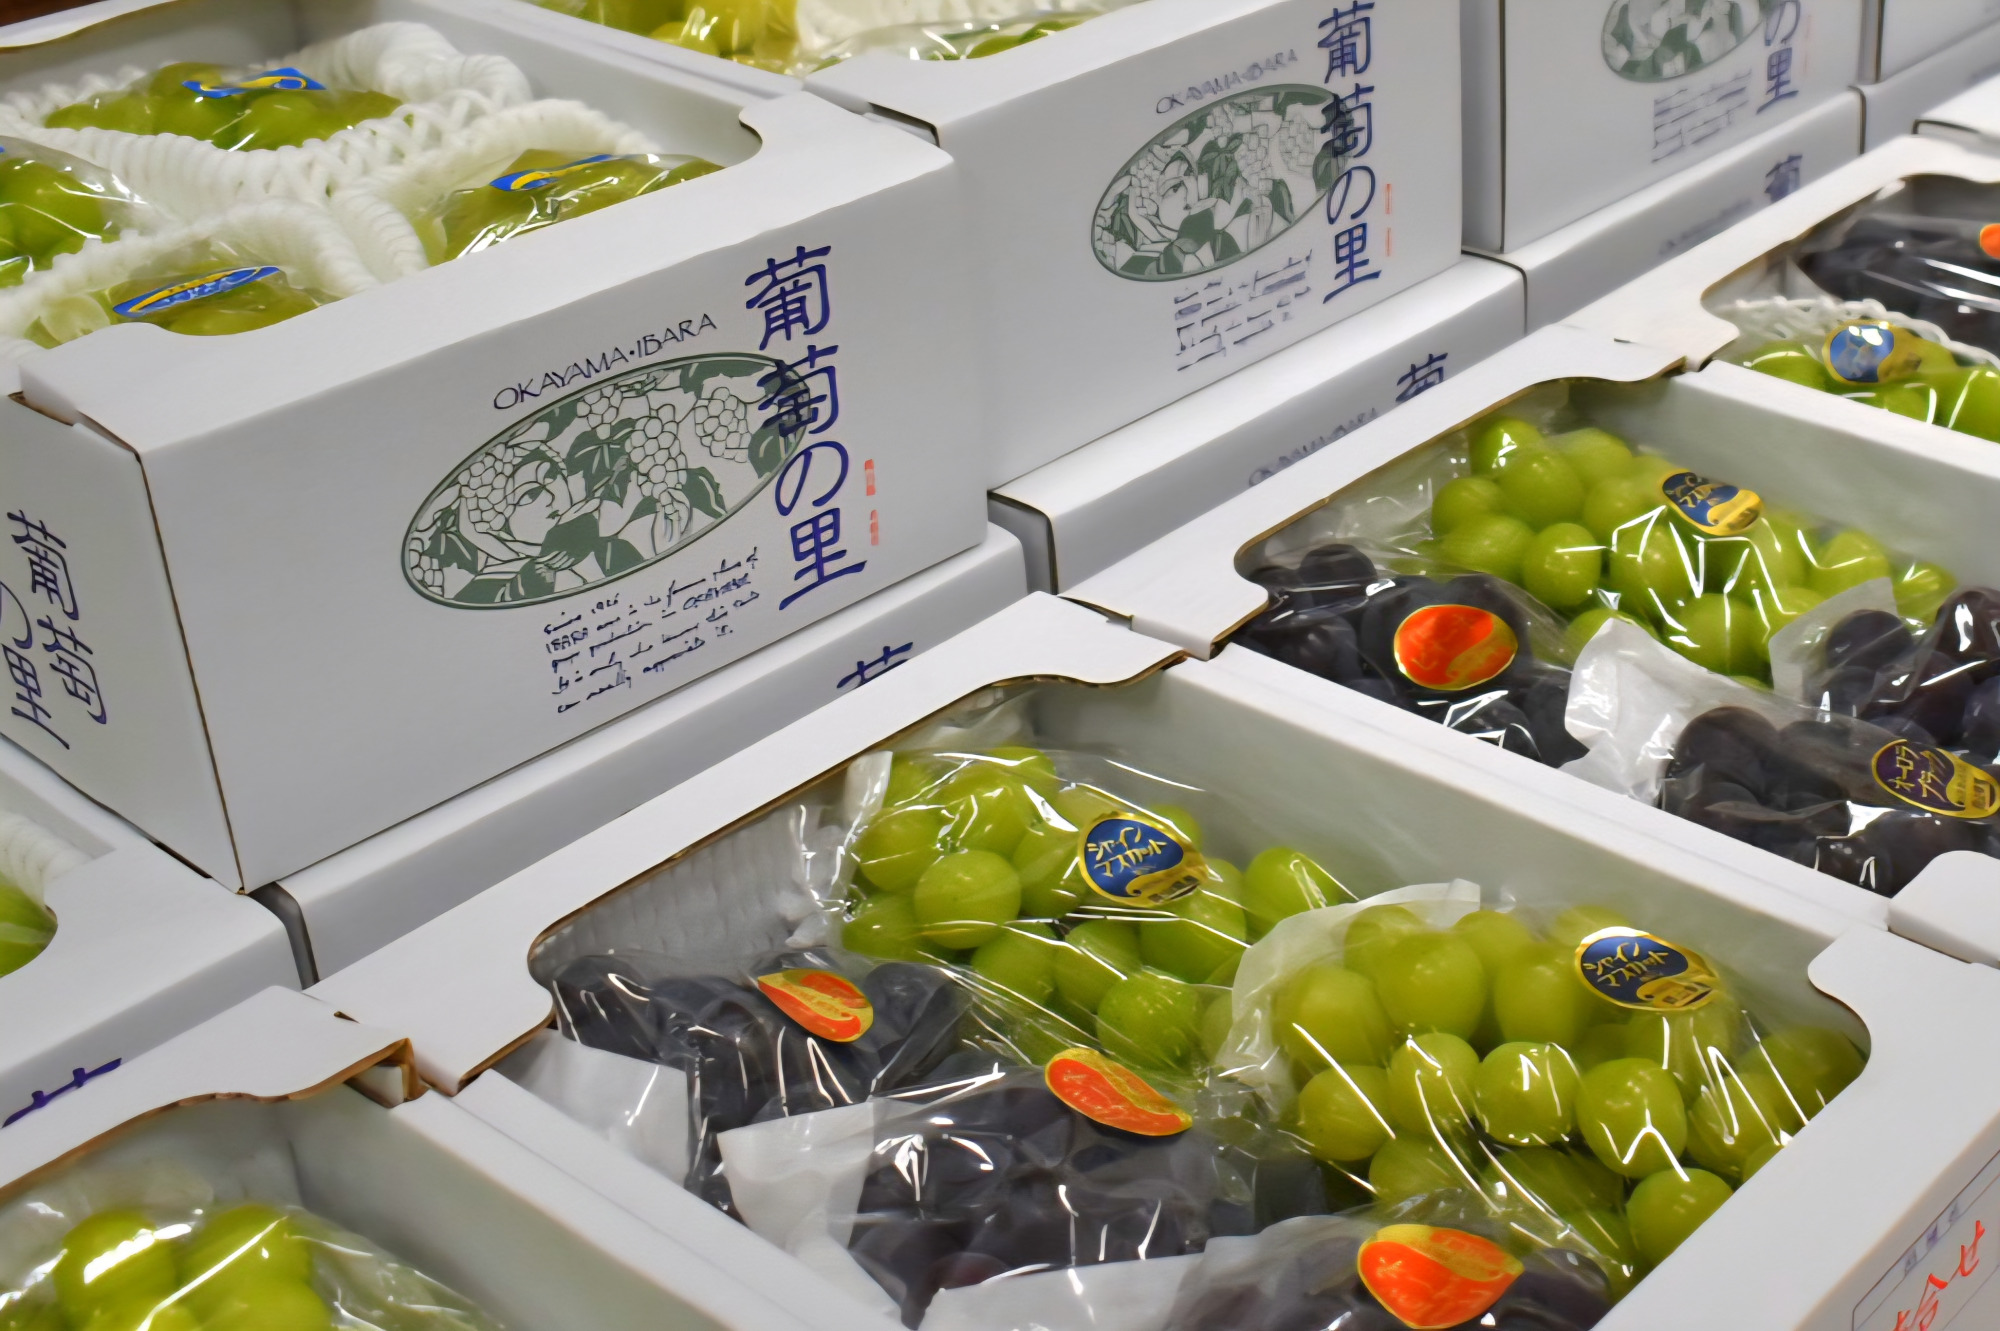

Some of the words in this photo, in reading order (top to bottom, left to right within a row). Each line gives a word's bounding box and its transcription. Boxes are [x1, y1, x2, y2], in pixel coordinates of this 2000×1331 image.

[1317, 1, 1382, 304] 葡萄の里
[744, 245, 868, 611] 葡萄の里
